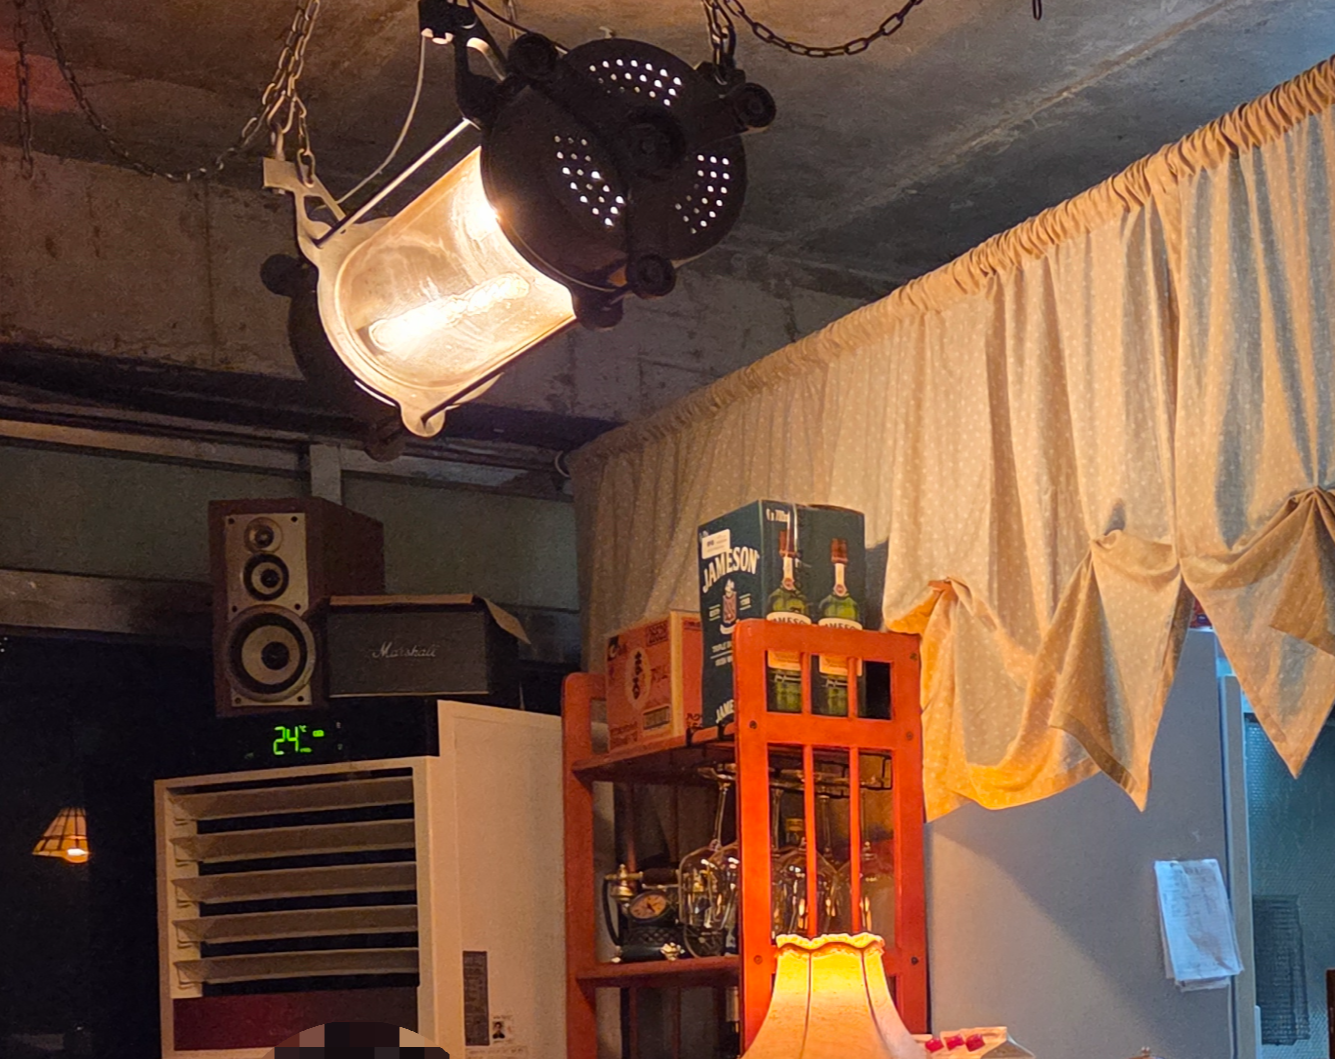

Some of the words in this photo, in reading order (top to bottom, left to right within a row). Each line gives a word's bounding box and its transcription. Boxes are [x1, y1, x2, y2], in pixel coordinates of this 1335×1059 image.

[702, 546, 759, 594] JAMESON
[371, 641, 438, 659] Marshall
[715, 699, 735, 724] JAME
